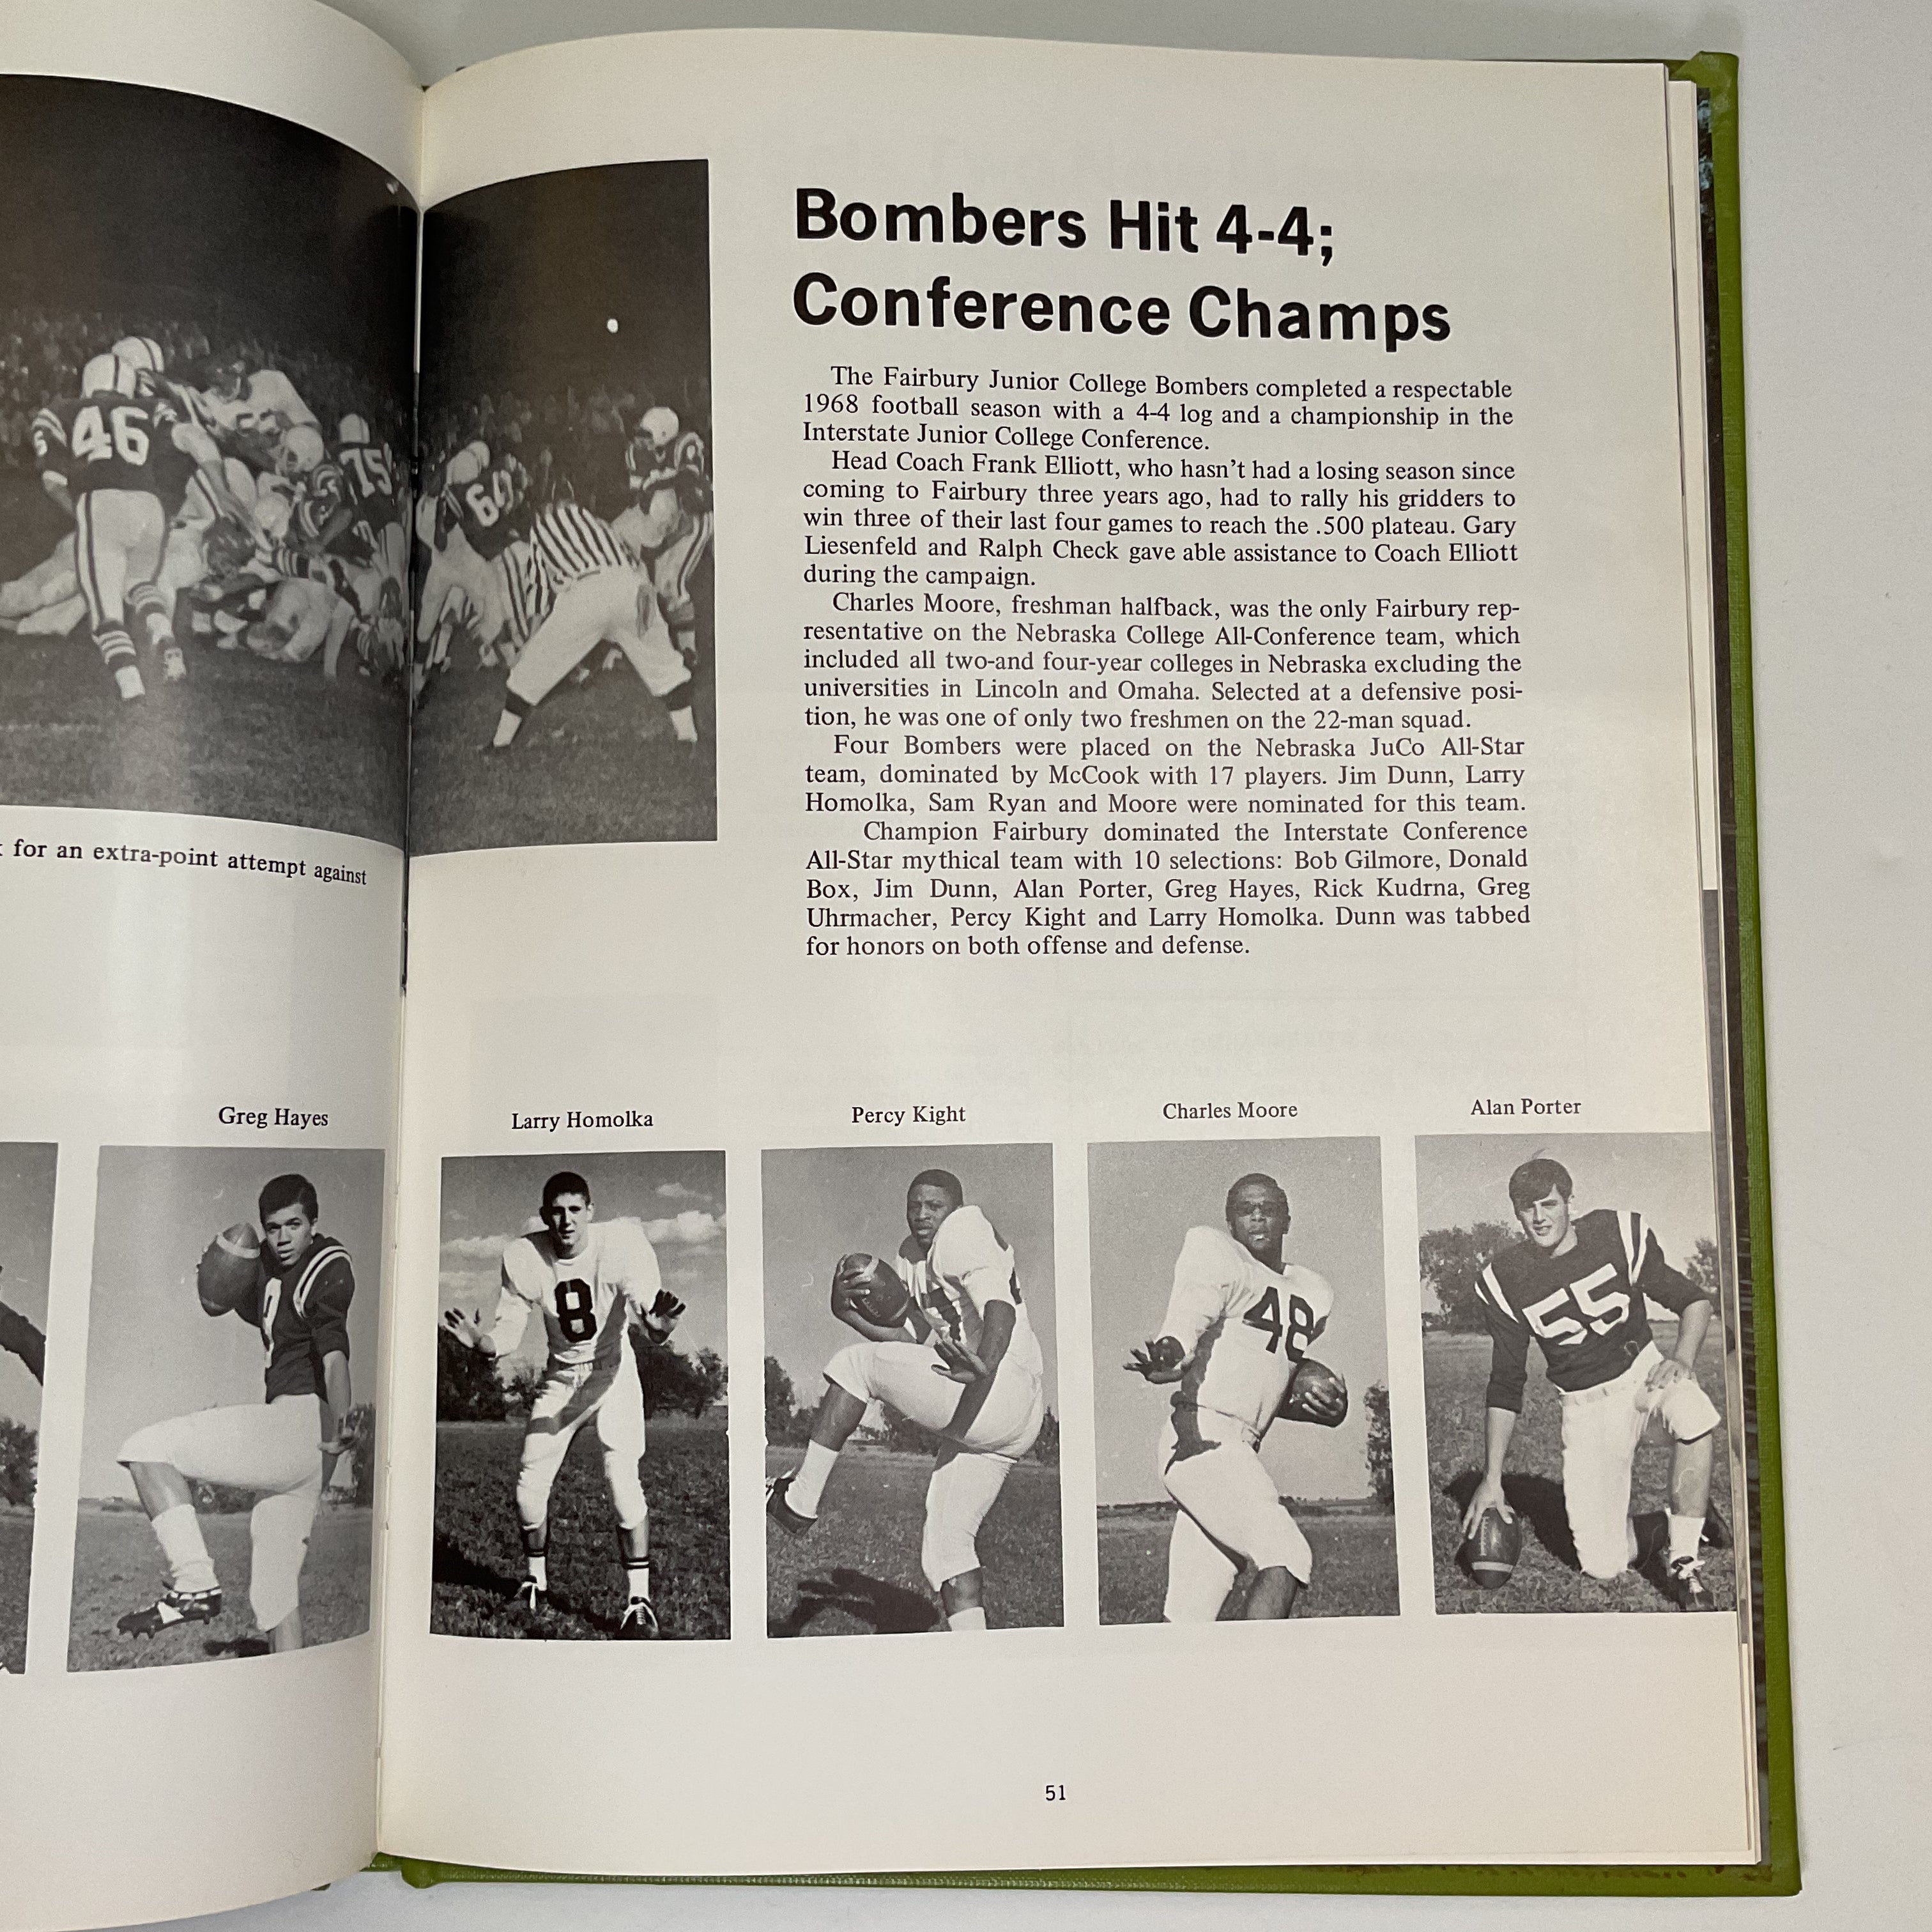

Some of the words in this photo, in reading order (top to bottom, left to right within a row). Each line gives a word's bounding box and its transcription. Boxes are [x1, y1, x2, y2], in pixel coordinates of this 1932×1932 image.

[796, 187, 1087, 249] Bombers
[1110, 199, 1199, 254] Hit
[1216, 204, 1333, 267] 4-4;
[793, 272, 1170, 336] Conference
[1189, 285, 1451, 353] Champs
[830, 365, 873, 385] The
[883, 366, 979, 393] Fairbury
[988, 369, 1059, 391] Junior
[1069, 372, 1147, 397] College
[1155, 375, 1248, 396] Bombers
[1256, 378, 1367, 402] completed
[1375, 385, 1386, 398] a
[1392, 379, 1512, 402] respectable
[72, 405, 150, 466] 46
[802, 421, 910, 442] Interstate
[917, 422, 988, 444] Junior
[995, 425, 1074, 451] College
[1082, 428, 1209, 450] Conference.
[340, 448, 392, 498] 75
[803, 479, 885, 503] coming
[896, 481, 919, 499] to
[931, 480, 1028, 507] Fairbury
[1038, 483, 1094, 503] three
[1103, 490, 1158, 509] years
[1168, 491, 1211, 510] ago,
[1220, 487, 1259, 507] had
[1269, 489, 1291, 507] to
[1300, 488, 1349, 512] rally
[1358, 488, 1389, 507] his
[1398, 488, 1484, 512] gridders
[1492, 489, 1515, 507] to
[804, 535, 917, 556] Liesenfeld
[928, 537, 967, 556] and
[978, 537, 1043, 562] Ralph
[1052, 539, 1119, 560] Check
[1129, 546, 1176, 564] gave
[1183, 542, 1226, 562] able
[1234, 543, 1337, 562] assistance
[1344, 545, 1367, 563] to
[1374, 543, 1441, 563] Coach
[1448, 542, 1519, 562] Elliott
[803, 563, 876, 588] during
[882, 564, 919, 584] the
[926, 566, 1036, 590] campaign.
[803, 621, 923, 641] resentative
[933, 627, 962, 641] on
[971, 622, 1007, 642] the
[1016, 622, 1117, 643] Nebraska
[1126, 624, 1205, 648] College
[1214, 626, 1376, 646] All-Conference
[1384, 628, 1445, 649] team,
[1455, 625, 1521, 645] which
[803, 648, 900, 669] included
[910, 650, 936, 669] all
[945, 651, 1034, 670] two-and
[1043, 650, 1142, 676] four-year
[1150, 653, 1233, 677] colleges
[1239, 654, 1261, 673] in
[1267, 654, 1368, 673] Nebraska
[1374, 654, 1480, 677] excluding
[1487, 653, 1522, 672] the
[804, 677, 929, 697] universities
[940, 678, 962, 698] in
[975, 678, 1059, 699] Lincoln
[1069, 680, 1107, 700] and
[1118, 680, 1199, 700] Omaha.
[1212, 681, 1300, 702] Selected
[1310, 684, 1331, 702] at
[1340, 687, 1352, 702] a
[1361, 681, 1461, 702] defensive
[1471, 680, 1523, 705] posi-
[834, 734, 889, 755] Four
[903, 735, 1001, 755] Bombers
[1015, 741, 1067, 756] were
[1080, 736, 1151, 760] placed
[1165, 742, 1193, 756] on
[1207, 737, 1241, 757] the
[1255, 737, 1356, 757] Nebraska
[1370, 737, 1425, 756] JuCo
[1440, 736, 1525, 756] All-Star
[804, 765, 866, 787] team,
[880, 763, 999, 784] dominated
[1011, 764, 1039, 788] by
[1048, 764, 1140, 785] McCook
[1149, 765, 1199, 785] with
[1209, 765, 1234, 785] 17
[1244, 766, 1327, 790] players.
[1338, 765, 1377, 785] Jim
[1387, 765, 1453, 788] Dunn,
[1465, 765, 1525, 787] Larry
[863, 820, 978, 845] Champion
[992, 820, 1089, 845] Fairbury
[1104, 822, 1220, 841] dominated
[1234, 822, 1269, 841] the
[1284, 822, 1388, 841] Interstate
[1403, 820, 1528, 841] Conference
[13, 838, 48, 858] for
[56, 845, 83, 859] an
[93, 845, 218, 868] extra-point
[227, 853, 307, 878] attempt
[314, 864, 367, 885] against
[805, 849, 893, 870] All-Star
[901, 849, 1000, 874] mythical
[1009, 851, 1064, 870] team
[1073, 850, 1123, 870] with
[1135, 850, 1160, 870] 10
[1170, 850, 1282, 870] selections:
[1294, 850, 1337, 870] Bob
[1345, 849, 1441, 872] Gilmore,
[1448, 848, 1528, 868] Donald
[806, 878, 858, 903] Box,
[873, 878, 913, 898] Jim
[930, 878, 997, 902] Dunn,
[1013, 878, 1064, 898] Alan
[1078, 878, 1153, 902] Porter,
[1165, 878, 1217, 903] Greg
[1229, 878, 1300, 902] Hayes,
[1313, 878, 1364, 898] Rick
[1376, 877, 1465, 900] Kudrna,
[1477, 877, 1530, 900] Greg
[806, 907, 937, 931] Uhrmacher,
[950, 907, 1012, 931] Percy
[1024, 907, 1086, 931] Kight
[1098, 907, 1137, 927] and
[1148, 907, 1208, 931] Larry
[1218, 907, 1324, 926] Homolka.
[1335, 906, 1396, 926] Dunn
[1405, 910, 1446, 925] was
[1455, 904, 1531, 924] tabbed
[806, 935, 840, 956] for
[846, 935, 924, 955] honors
[932, 940, 961, 955] on
[967, 935, 1020, 955] both
[1027, 935, 1108, 955] offense
[1115, 935, 1154, 954] and
[1162, 934, 1250, 954] defense.
[218, 1106, 268, 1129] Greg
[273, 1107, 328, 1130] Hayes
[851, 1107, 906, 1127] Percy
[912, 1105, 966, 1126] Kight
[1163, 1102, 1231, 1119] Charles
[1237, 1101, 1298, 1118] Moore
[1470, 1099, 1515, 1116] Alan
[1521, 1098, 1582, 1115] Porter
[511, 1113, 561, 1133] Larry
[566, 1110, 654, 1128] Homolka
[554, 1278, 597, 1343] 8
[1521, 1262, 1630, 1346] 55
[1243, 1285, 1315, 1363] 48
[1045, 1784, 1066, 1802] 51
